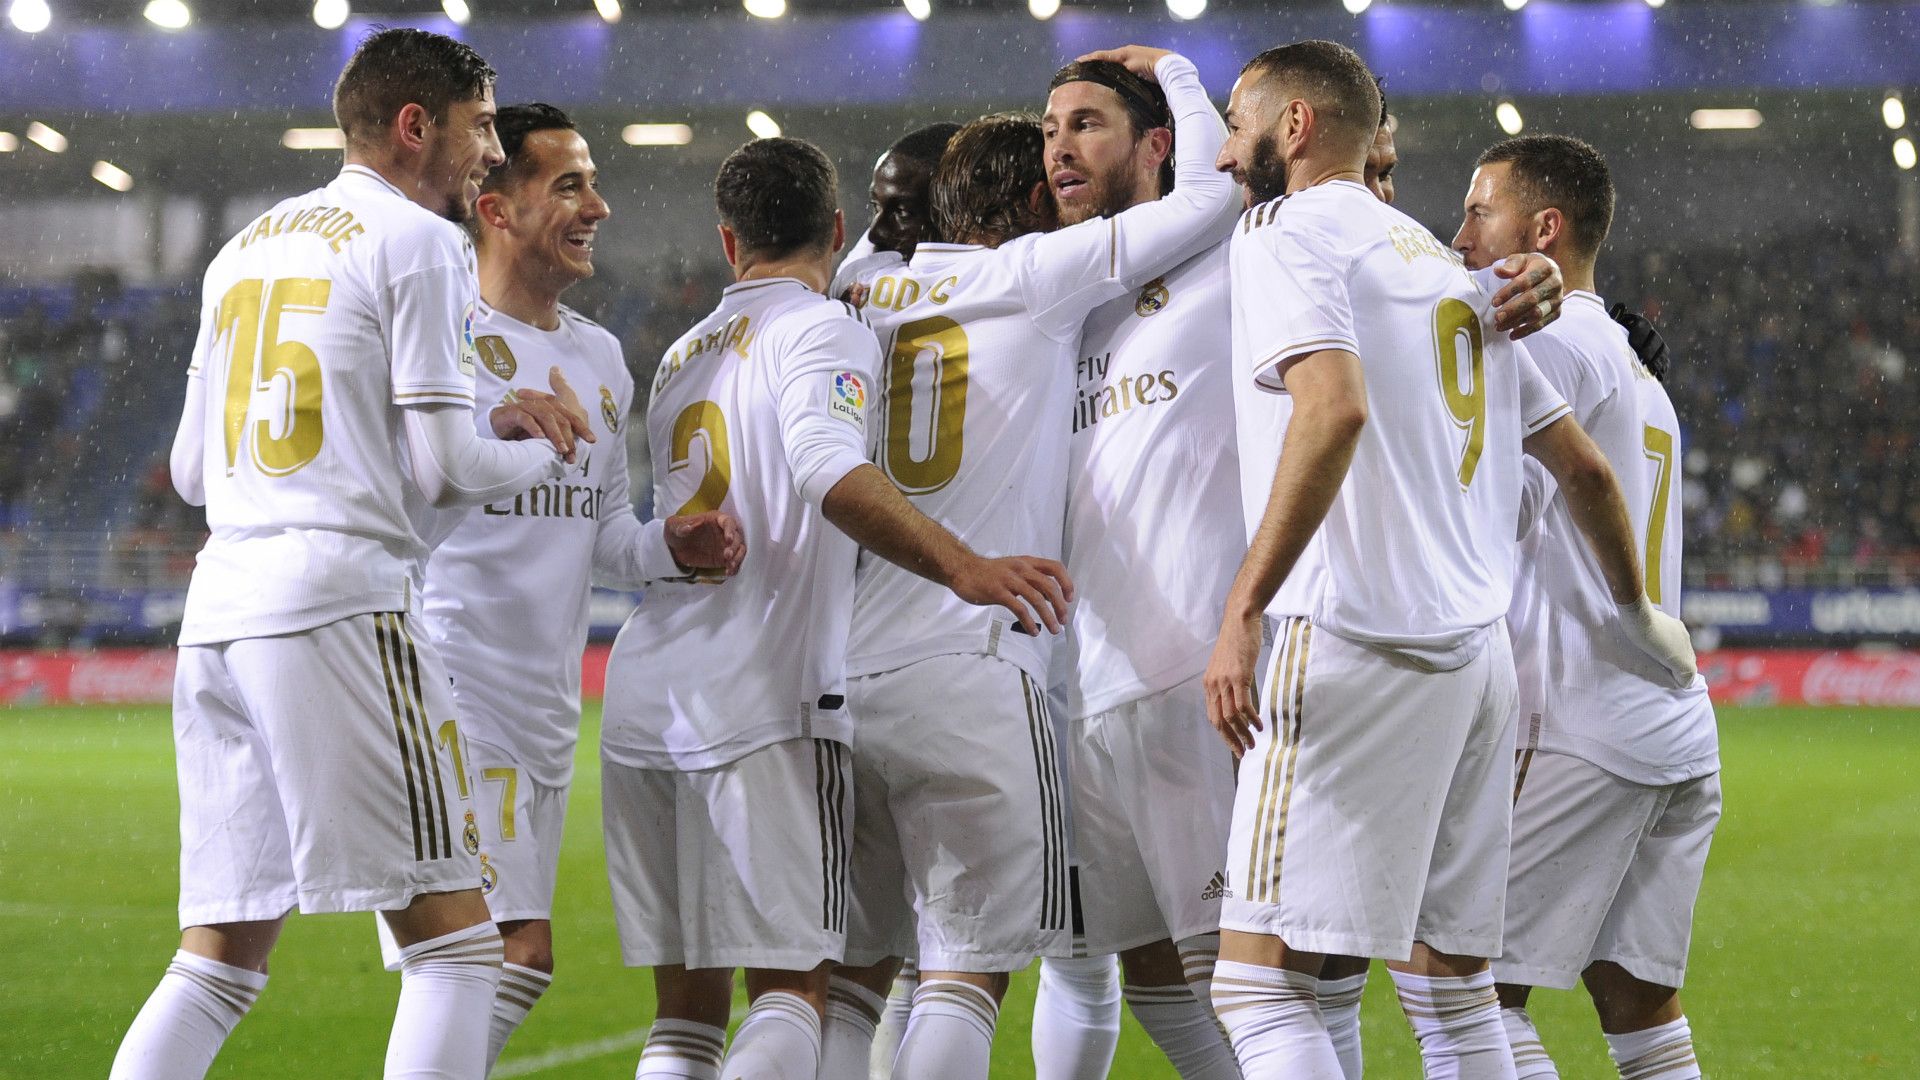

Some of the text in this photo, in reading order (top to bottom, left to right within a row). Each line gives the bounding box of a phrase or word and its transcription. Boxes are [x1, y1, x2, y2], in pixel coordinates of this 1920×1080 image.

[239, 205, 366, 255] VALVERDE
[211, 277, 333, 478] 15
[833, 401, 863, 426] LaLiga
[1072, 369, 1178, 434] irates
[1431, 297, 1487, 494] 9
[668, 400, 732, 584] 2
[1643, 420, 1673, 606] 7
[480, 767, 519, 842] 7
